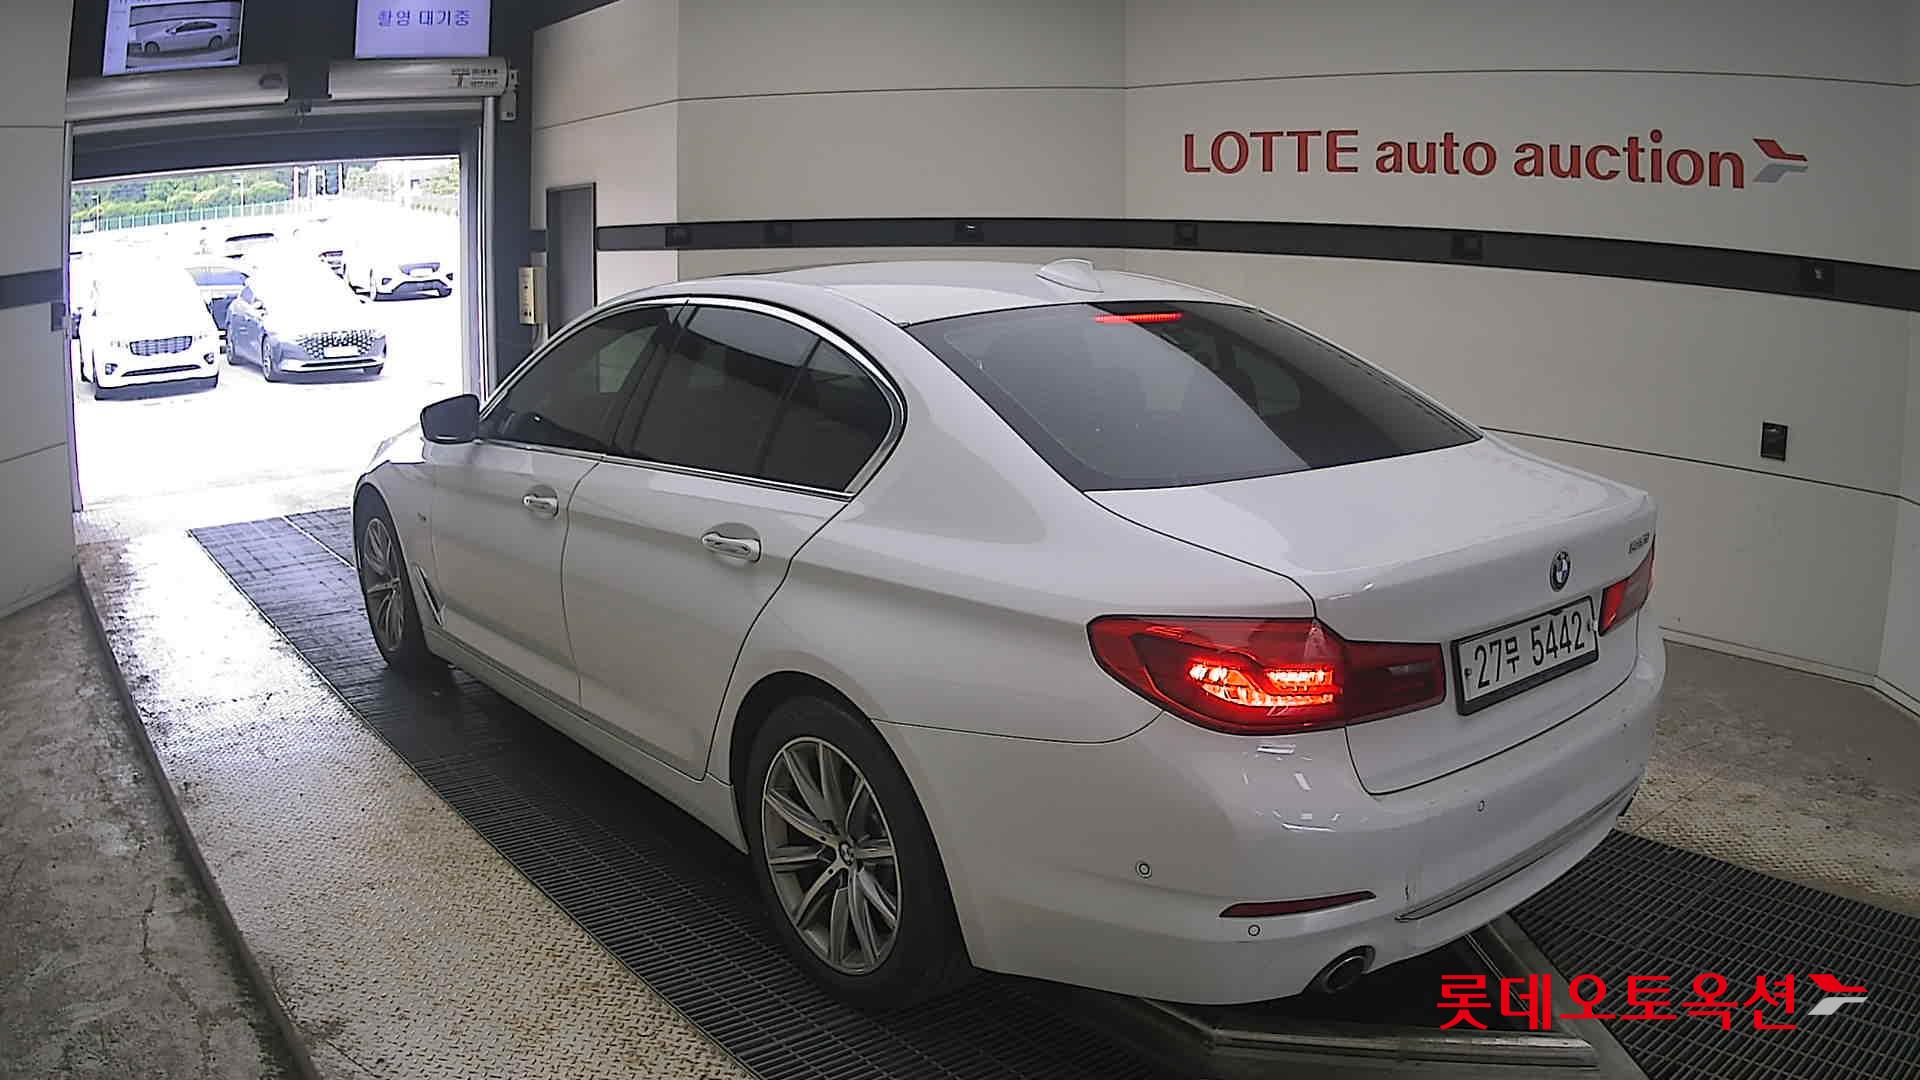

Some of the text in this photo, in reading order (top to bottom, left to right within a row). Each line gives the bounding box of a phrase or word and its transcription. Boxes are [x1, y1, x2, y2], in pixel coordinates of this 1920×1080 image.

[419, 9, 471, 26] 대기중
[1184, 129, 1745, 189] LOTTE auto auction
[1474, 611, 1585, 688] 27무 5442
